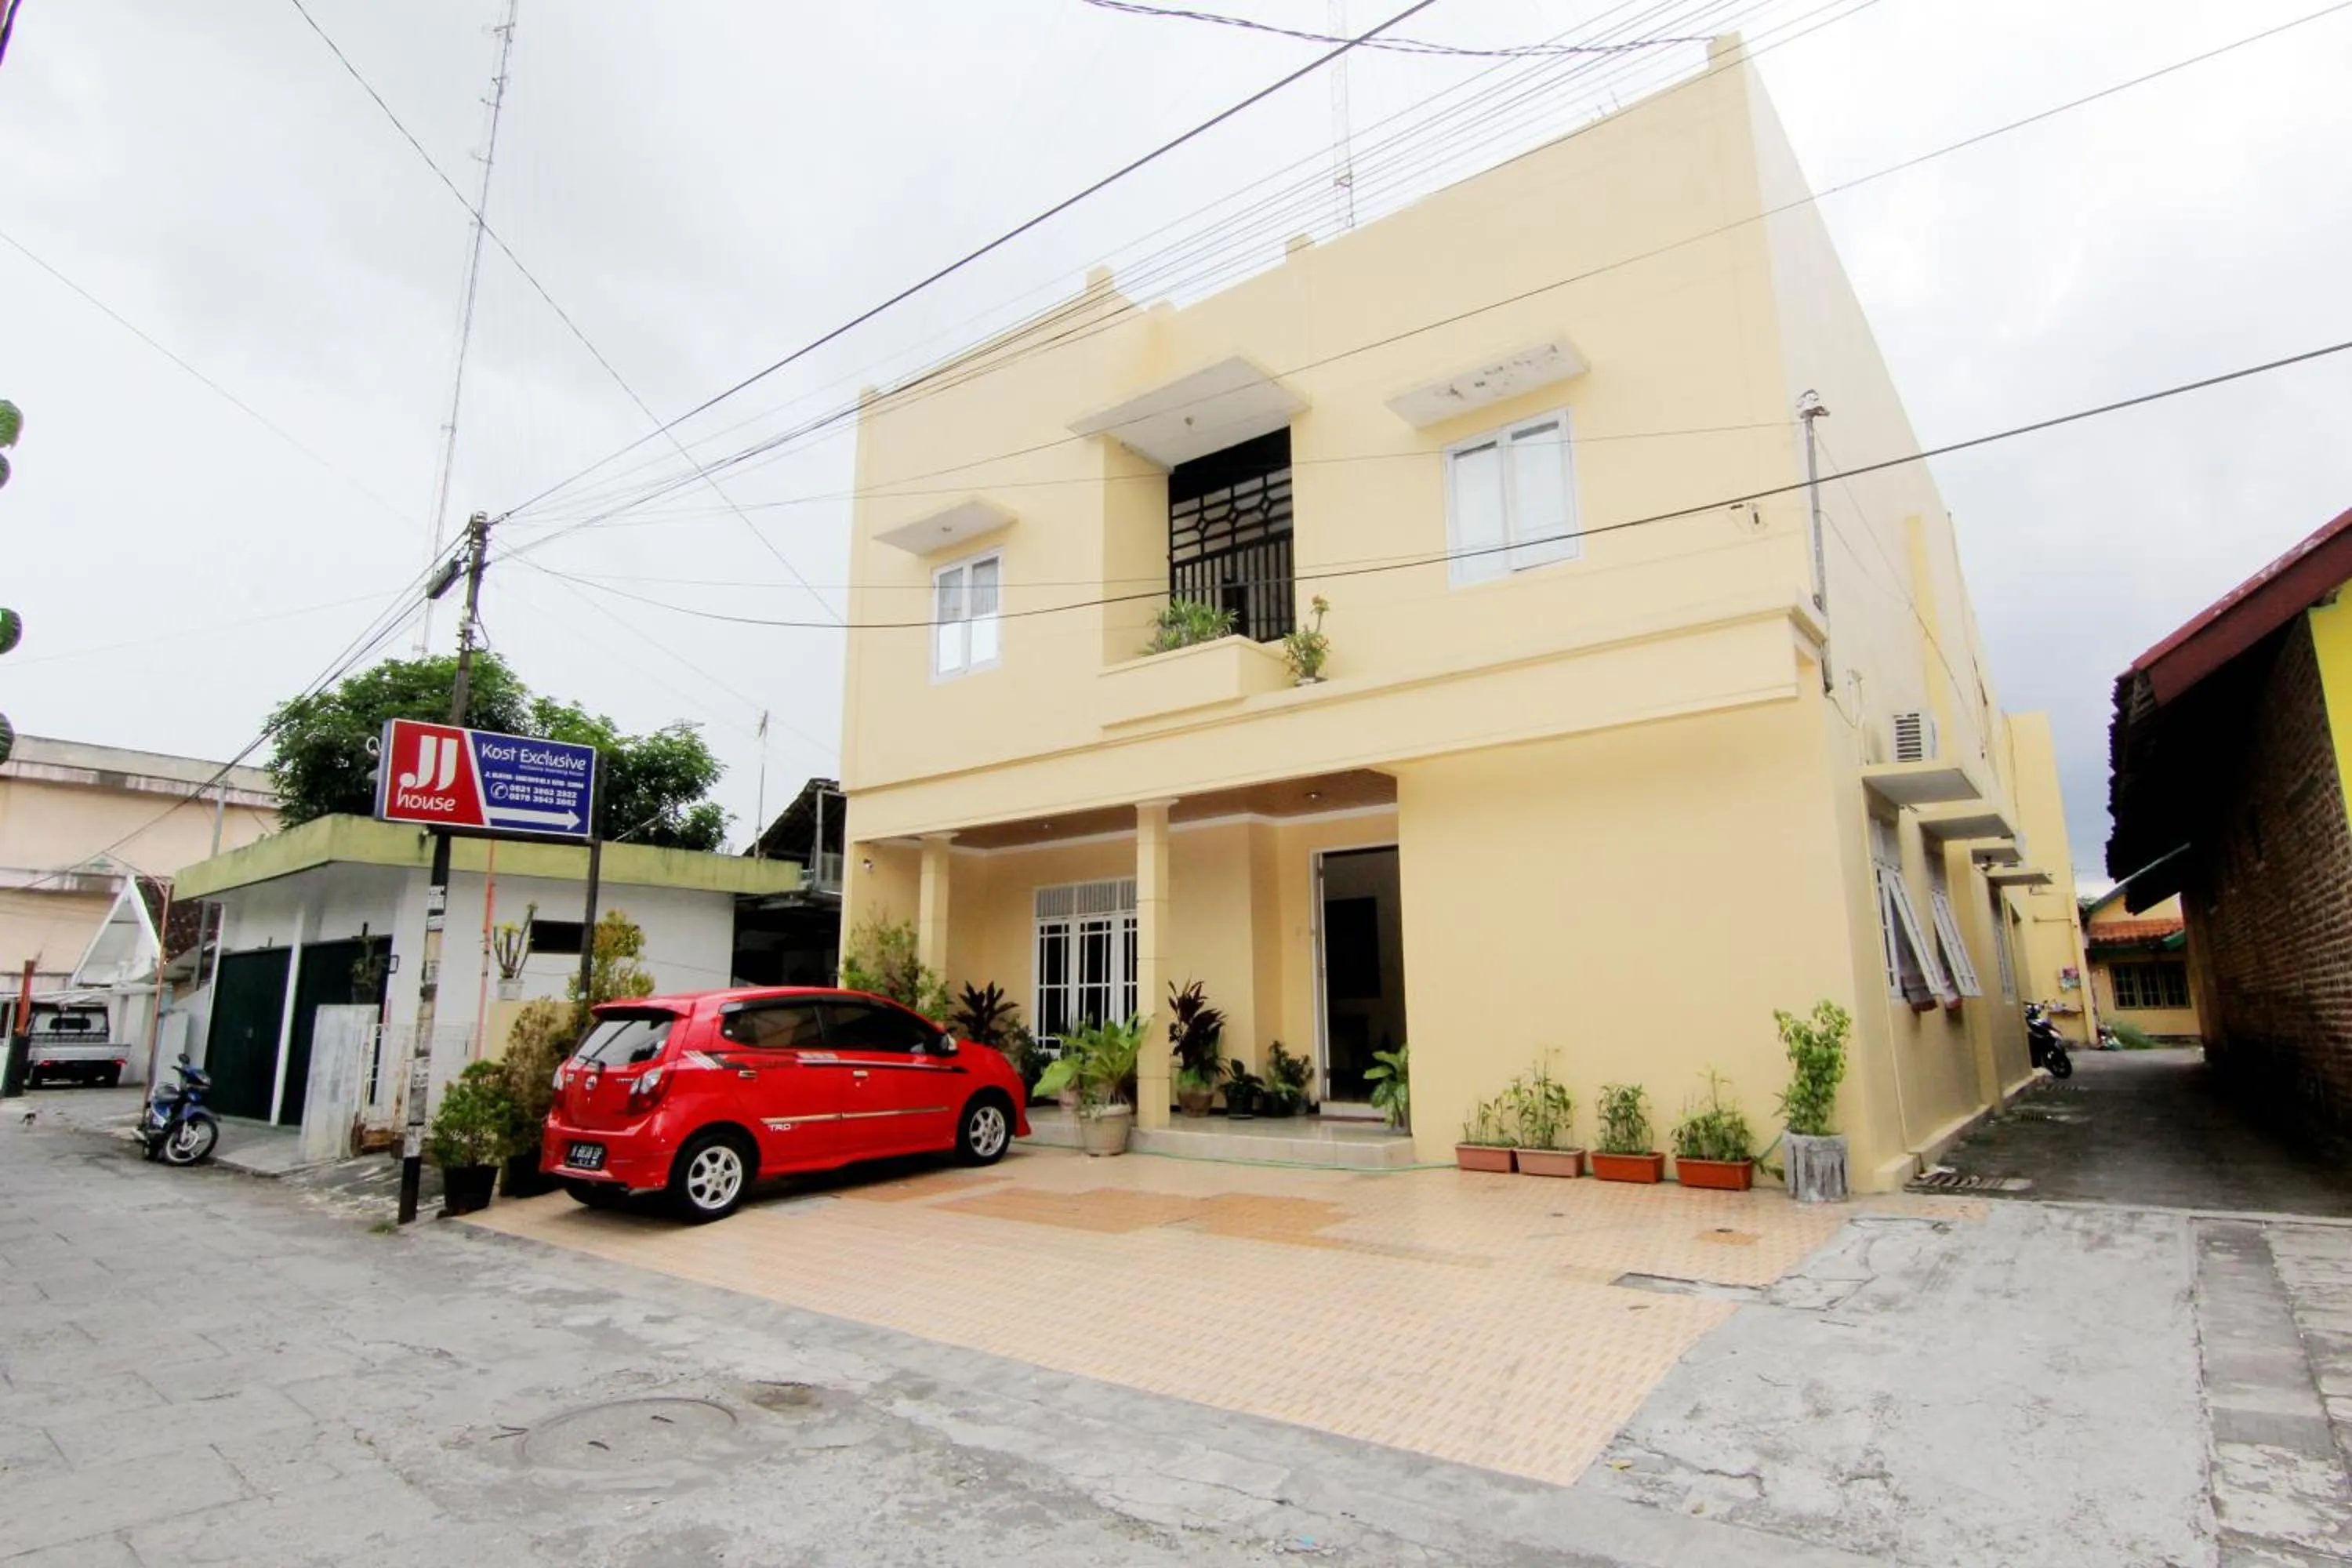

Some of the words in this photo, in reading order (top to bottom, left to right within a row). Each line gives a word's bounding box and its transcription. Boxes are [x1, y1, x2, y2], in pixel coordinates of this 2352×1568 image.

[398, 735, 459, 791] JJ
[481, 742, 517, 761] Kost
[520, 749, 586, 771] Exclusive
[396, 786, 456, 811] house
[768, 1123, 791, 1133] TRD
